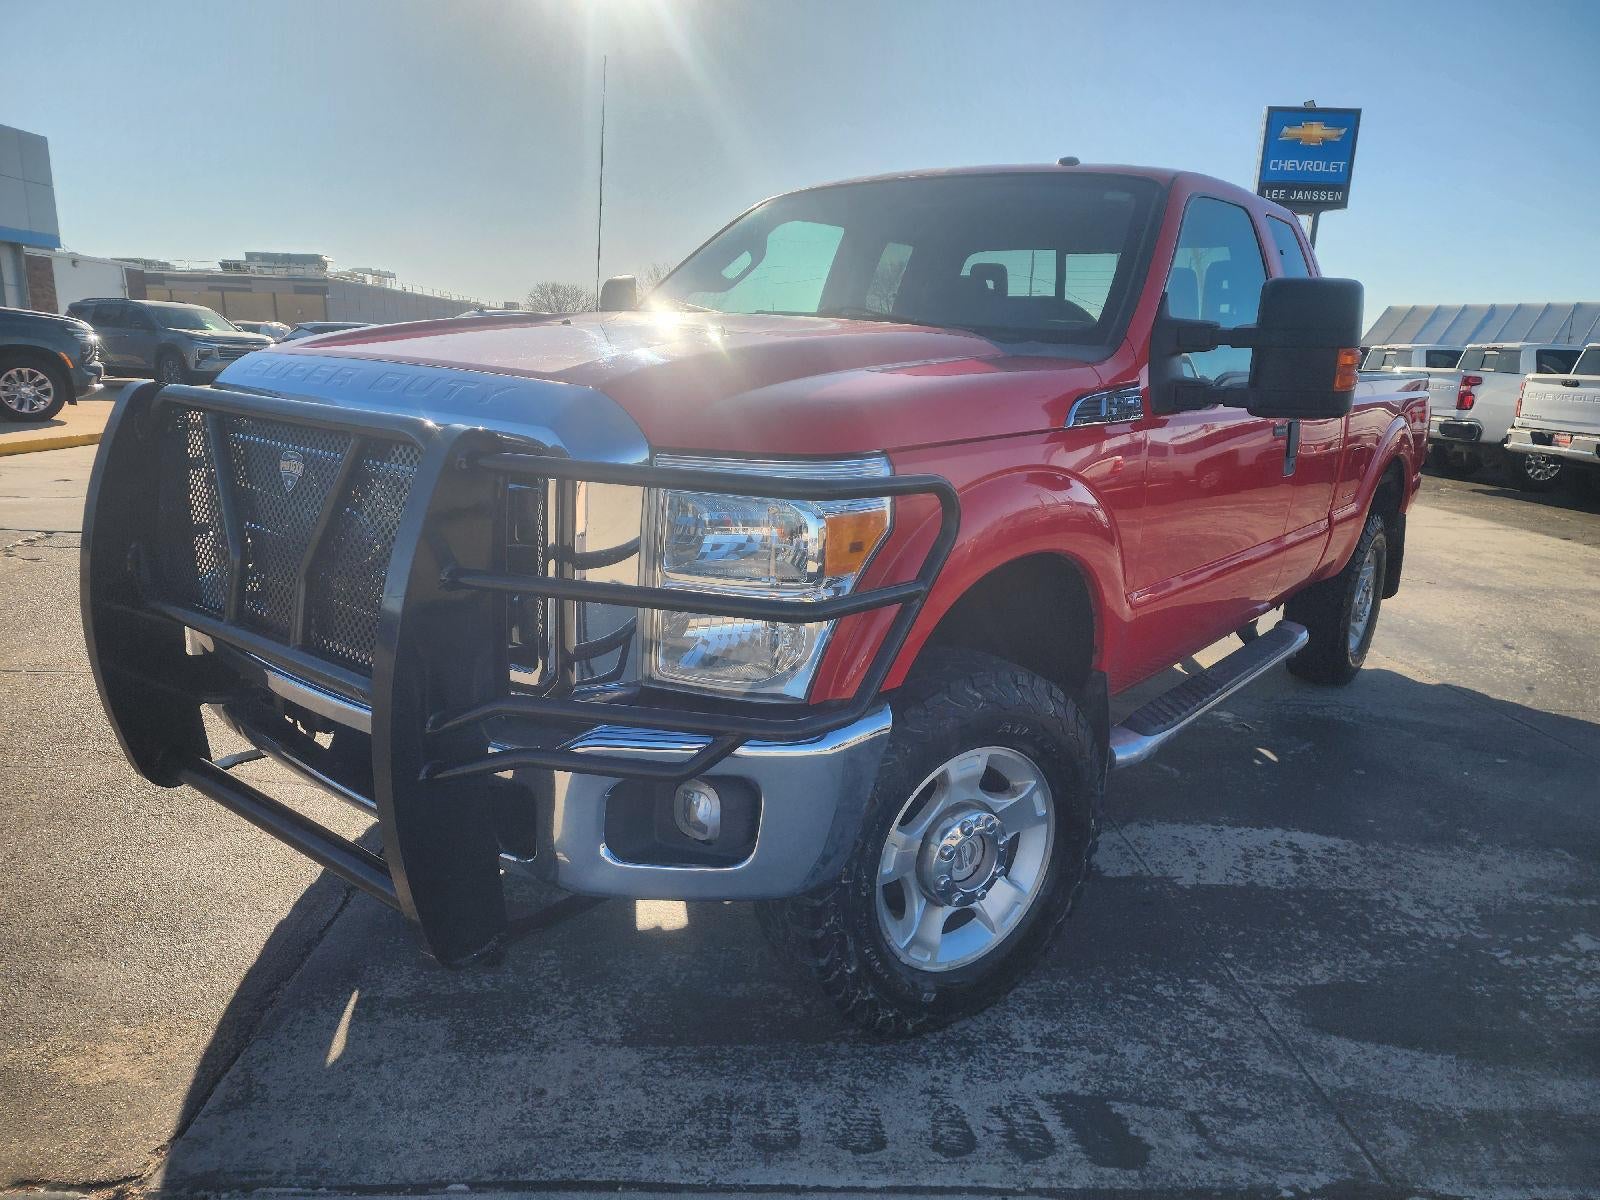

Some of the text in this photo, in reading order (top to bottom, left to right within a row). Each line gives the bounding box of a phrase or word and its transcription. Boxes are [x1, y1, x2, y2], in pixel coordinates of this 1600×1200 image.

[1269, 159, 1347, 173] CHEVROLET
[1264, 189, 1343, 201] LEE JANSSEN
[244, 358, 520, 405] SUPER DUTY
[1526, 391, 1600, 404] CHEVROLE
